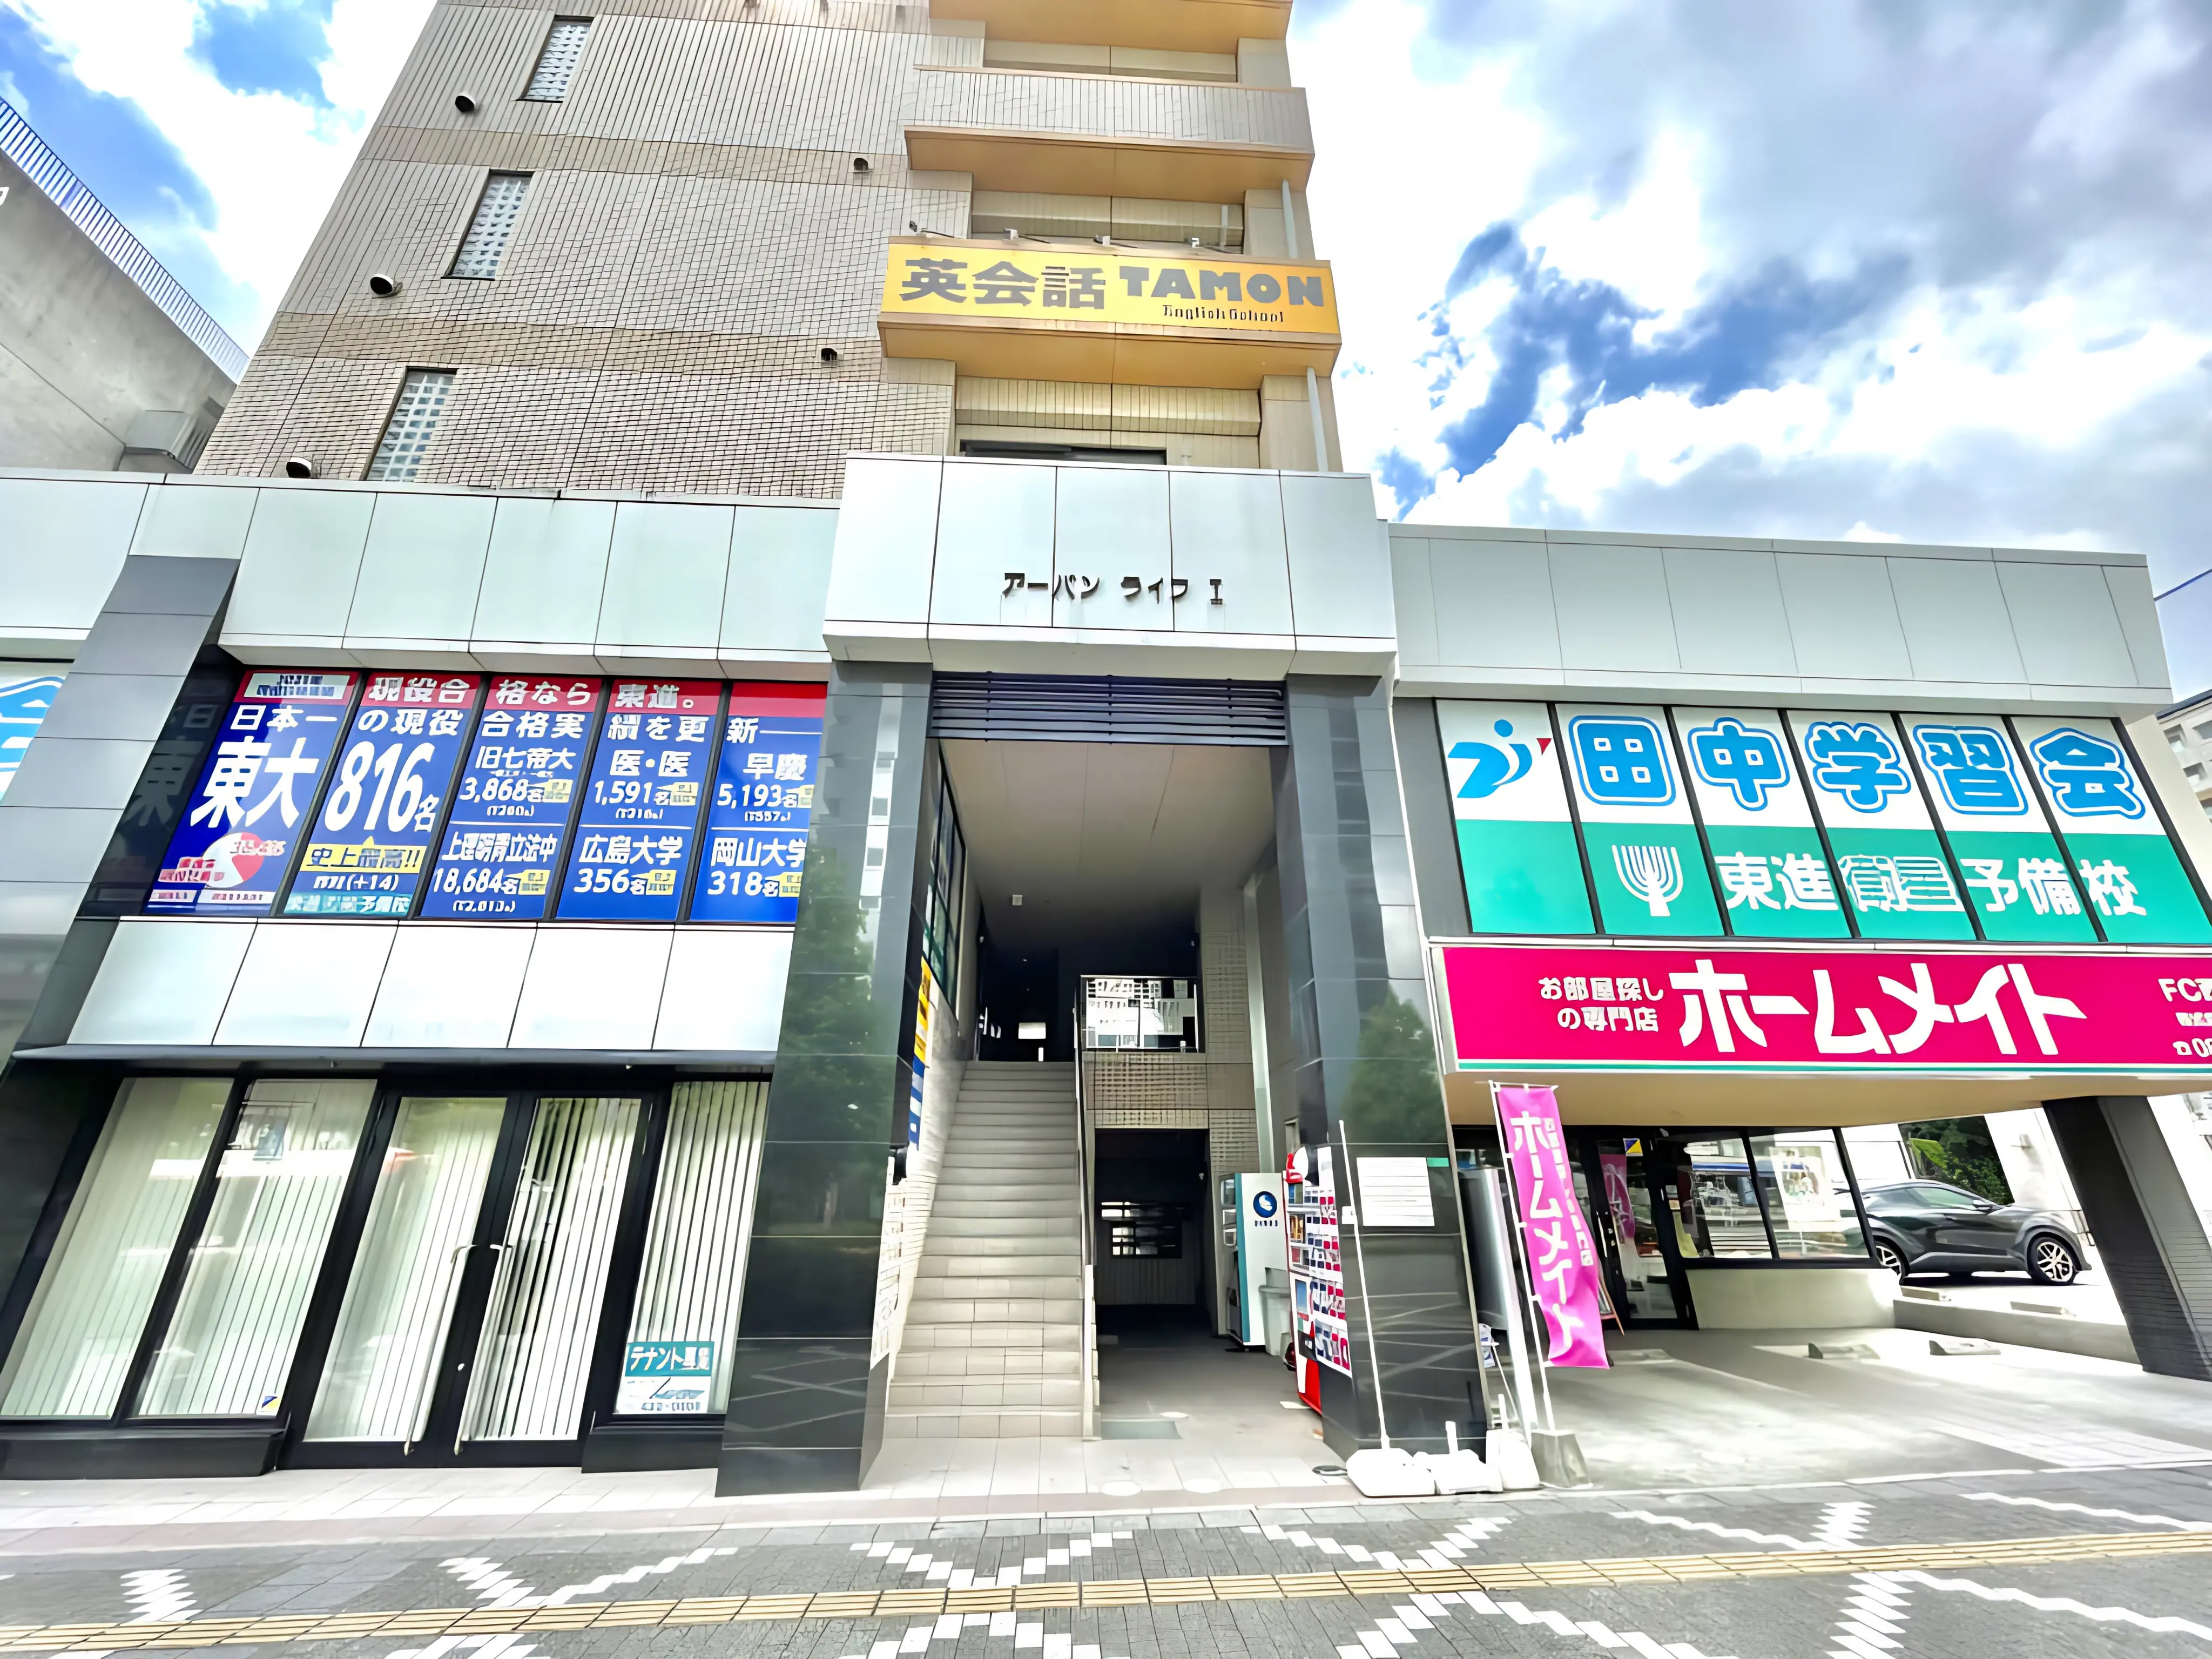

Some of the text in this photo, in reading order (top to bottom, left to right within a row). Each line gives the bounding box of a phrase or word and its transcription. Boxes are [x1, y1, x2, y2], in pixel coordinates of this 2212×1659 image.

[899, 258, 1324, 310] 英会話 TAMON
[1002, 572, 1100, 601] アーバン
[1121, 577, 1188, 604] ライフ
[475, 746, 576, 769] 旧七帝大
[1568, 715, 2146, 819] 田中学習会
[190, 736, 319, 828] 東大
[325, 741, 440, 832] 816名
[579, 835, 683, 866] 広島大学
[711, 838, 807, 868] 岡山大学
[574, 869, 646, 894] 356名
[707, 872, 779, 896] 318名
[1668, 959, 2087, 1055] ホームメイト
[1510, 1111, 1584, 1358] ホームメイト
